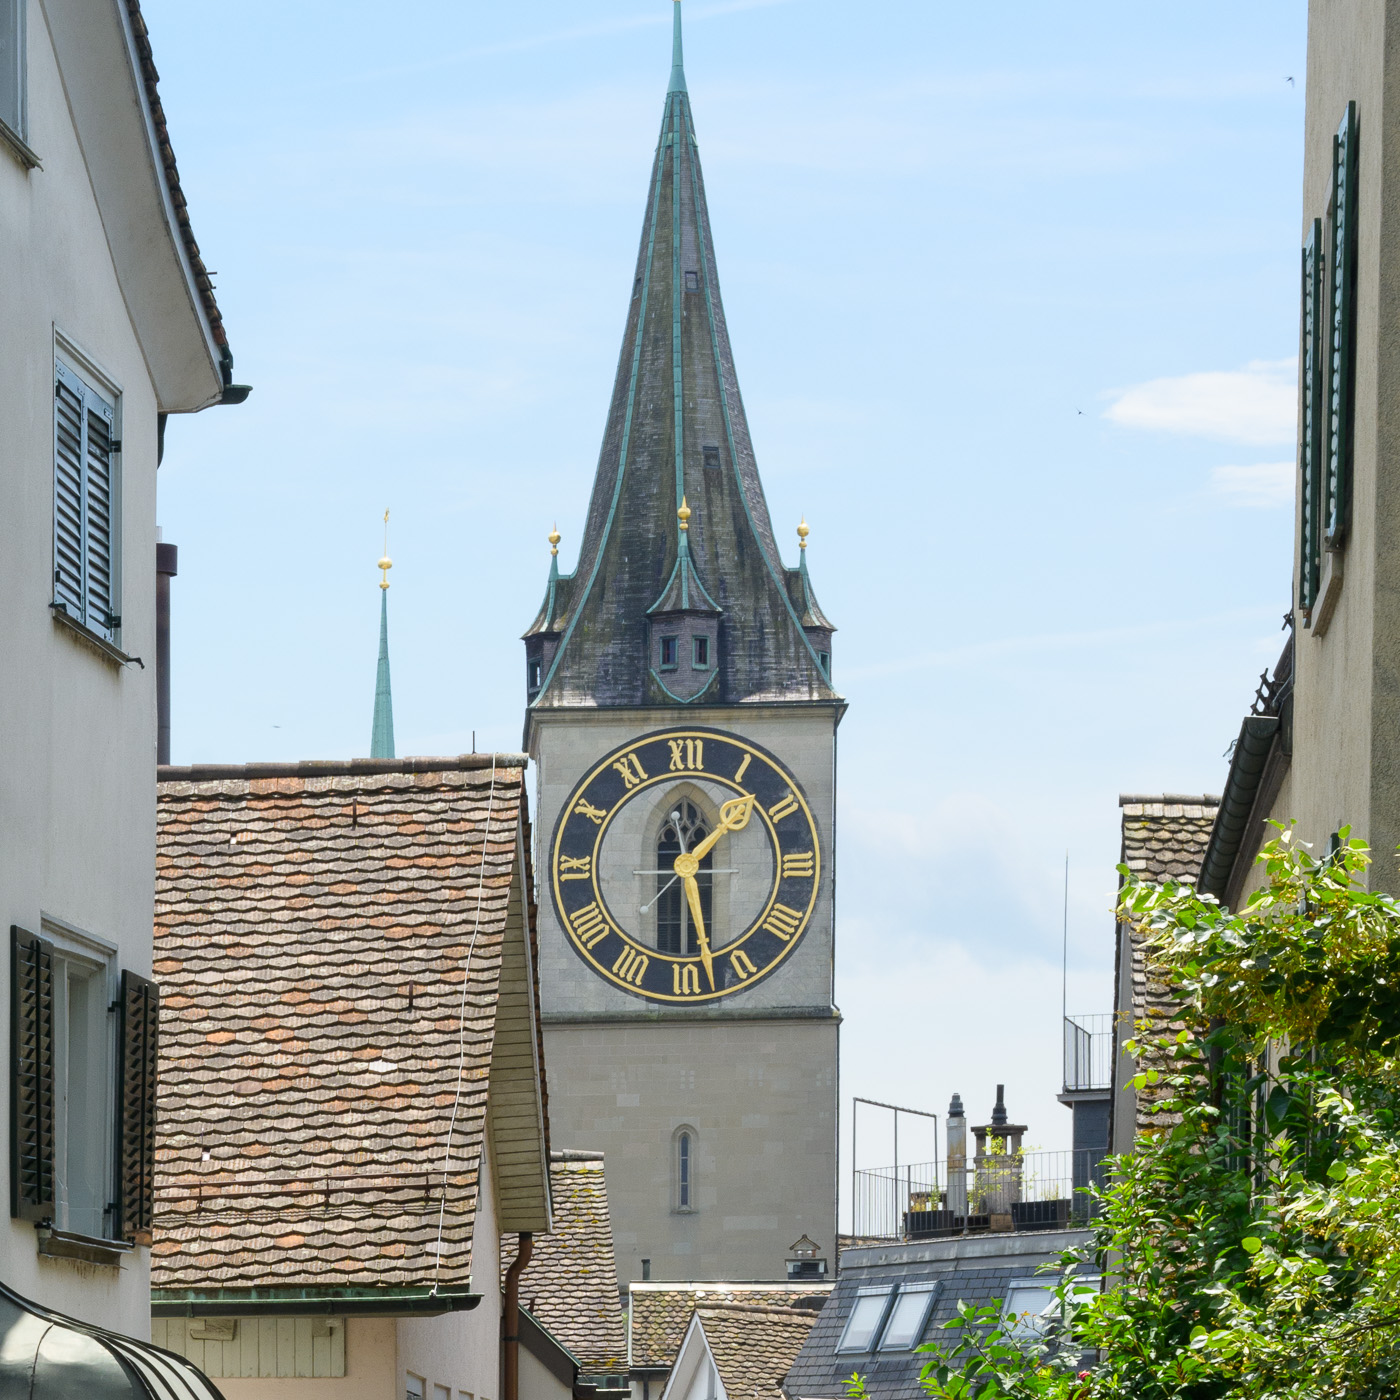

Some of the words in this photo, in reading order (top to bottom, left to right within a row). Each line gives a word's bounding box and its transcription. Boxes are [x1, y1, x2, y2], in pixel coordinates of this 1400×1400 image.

[668, 738, 704, 771] XII
[734, 753, 752, 783] I
[612, 752, 648, 789] XI
[574, 797, 607, 825] X
[559, 854, 591, 882] IX
[783, 850, 814, 879] III
